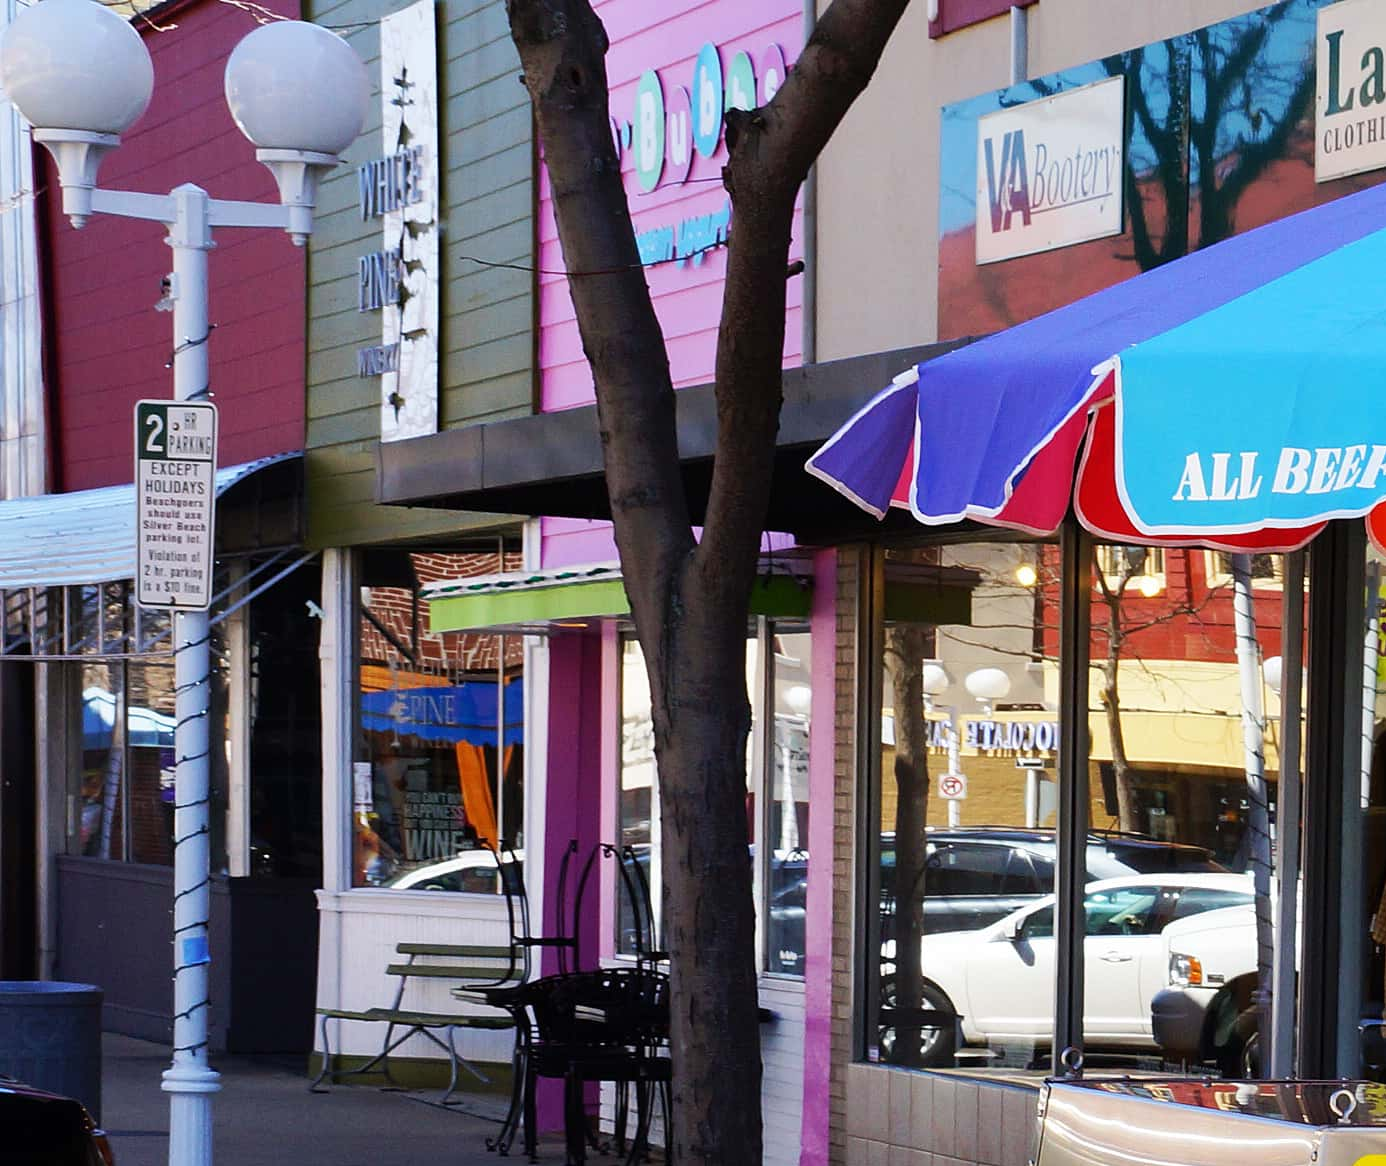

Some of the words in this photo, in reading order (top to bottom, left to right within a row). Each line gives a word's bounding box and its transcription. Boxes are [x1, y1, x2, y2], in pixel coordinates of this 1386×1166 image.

[358, 146, 422, 222] WHITE
[984, 129, 1032, 234] VA
[359, 247, 400, 313] PINE
[146, 414, 163, 452] 2
[169, 435, 211, 454] PARKING
[151, 463, 200, 476] EXCEPT
[1172, 451, 1263, 500] ALL
[145, 480, 205, 494] HOLIDAYS
[146, 497, 204, 508] Beachgoers
[148, 510, 180, 519] should
[144, 522, 172, 531] Silver
[176, 523, 206, 532] Beach
[146, 534, 182, 544] parking
[149, 551, 187, 562] Violation
[192, 552, 200, 562] of
[144, 565, 151, 576] 2
[170, 567, 203, 579] parking
[164, 582, 181, 593] $10
